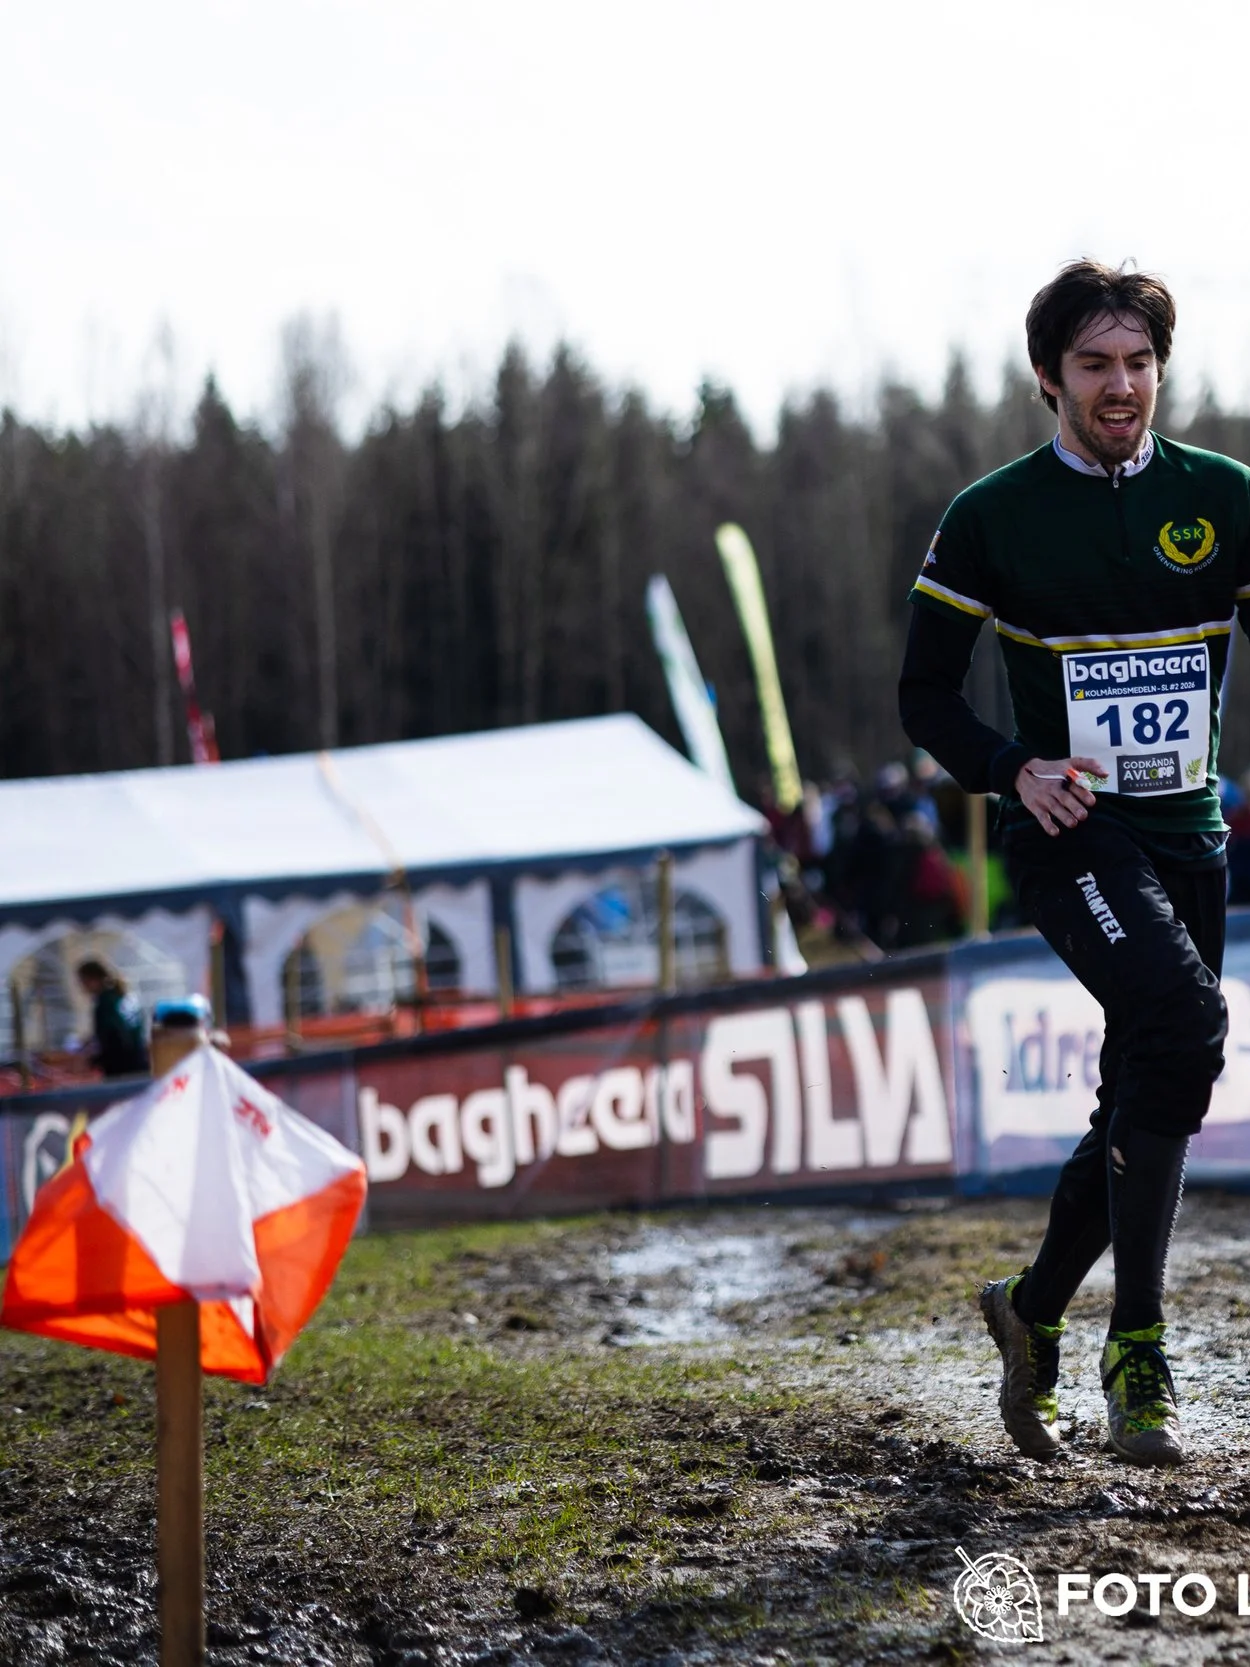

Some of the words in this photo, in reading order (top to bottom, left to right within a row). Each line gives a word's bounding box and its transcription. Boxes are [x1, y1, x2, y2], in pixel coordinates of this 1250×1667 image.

[1172, 528, 1202, 541] SSK
[1152, 546, 1194, 575] ORIENTERING
[1068, 654, 1206, 684] bagheera
[1085, 684, 1157, 697] KOLMÅRDSMEDELN
[1096, 699, 1190, 747] 182
[1122, 757, 1175, 769] GODKÄNDA
[1123, 766, 1175, 781] AVLOPP
[1076, 871, 1127, 945] TRIMTEX
[702, 987, 953, 1180] SILVA
[357, 1060, 695, 1188] bagheera
